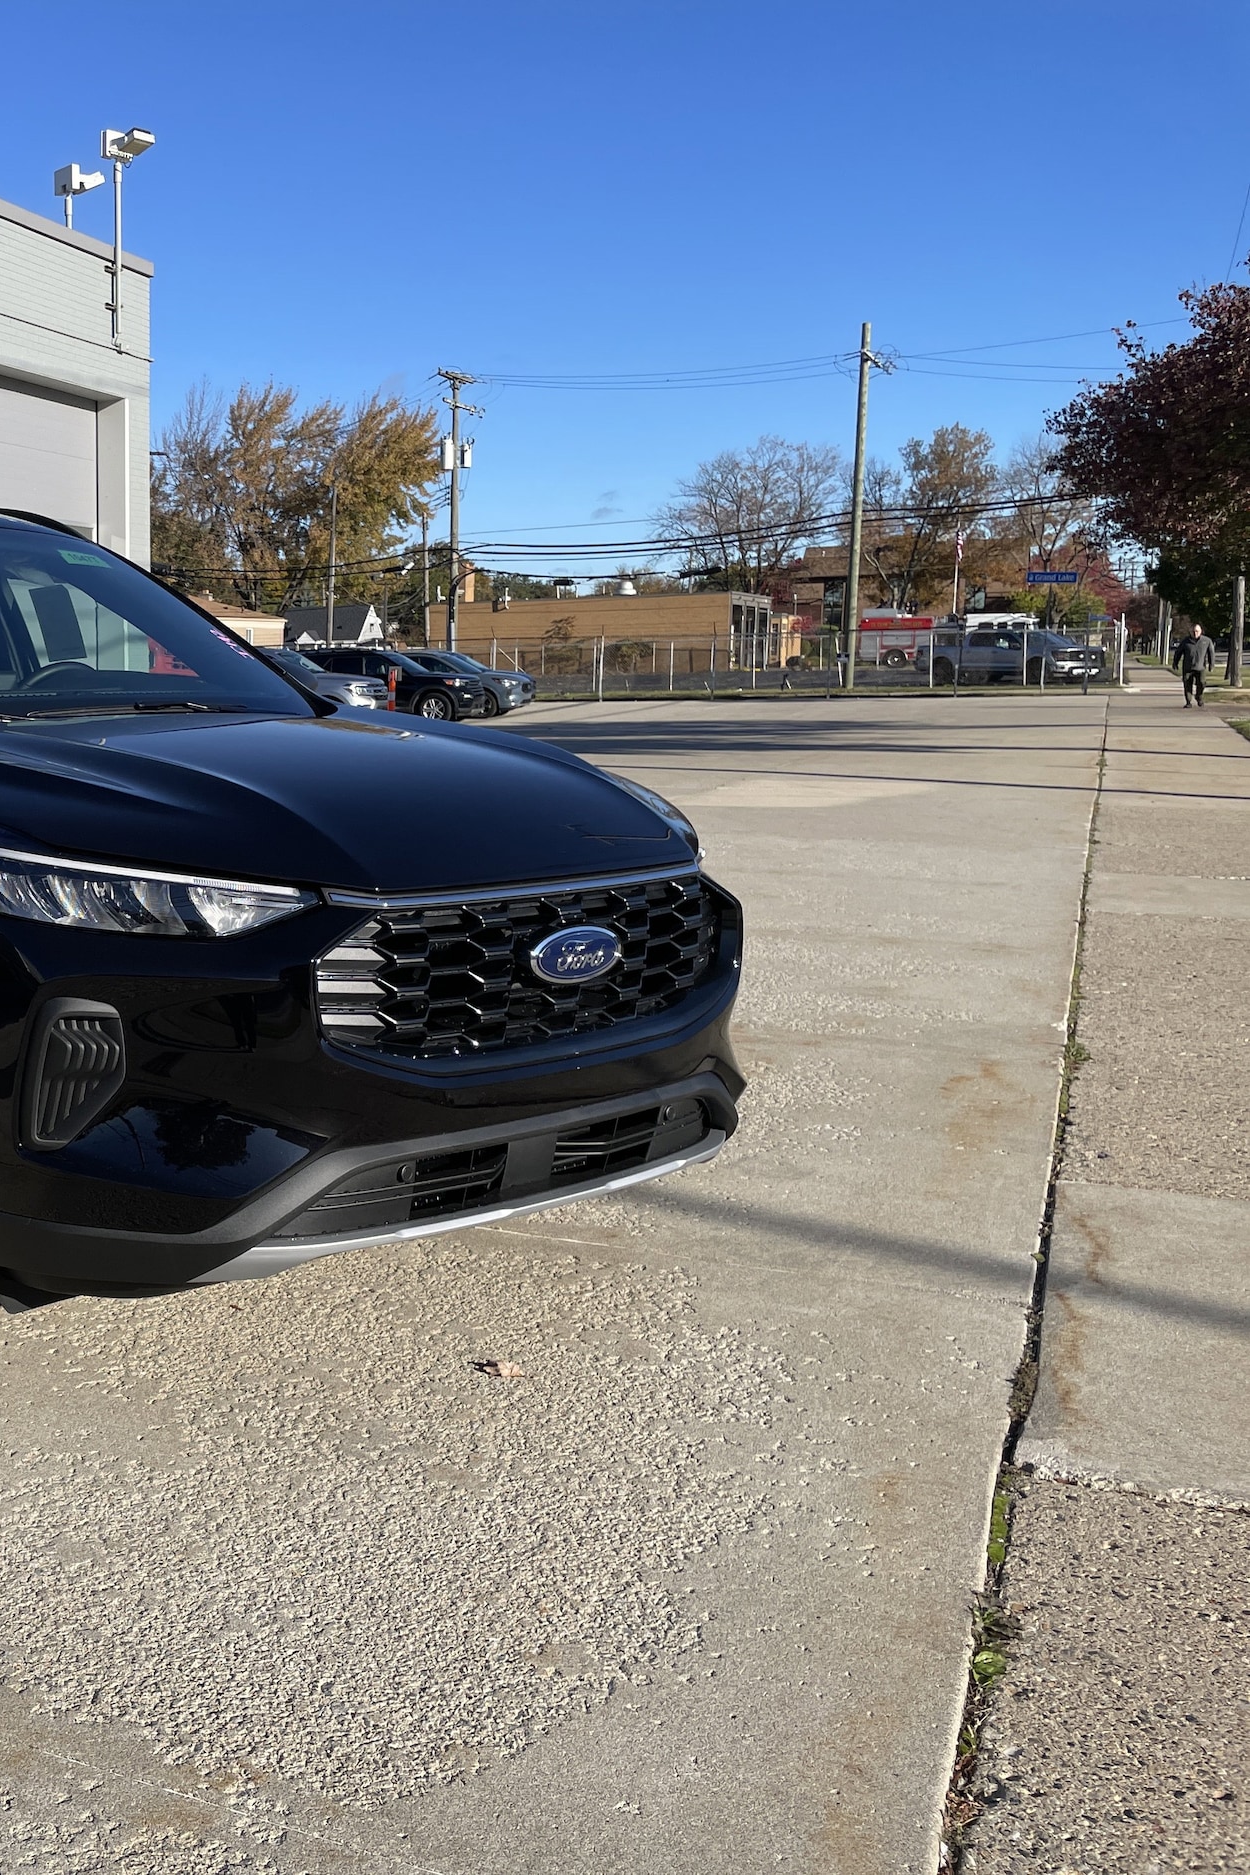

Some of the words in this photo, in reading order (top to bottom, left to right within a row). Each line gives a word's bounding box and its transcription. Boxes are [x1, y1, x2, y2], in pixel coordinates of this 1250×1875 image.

[1034, 573, 1057, 582] Grand
[1058, 573, 1075, 582] Lake
[557, 938, 607, 972] Ford
